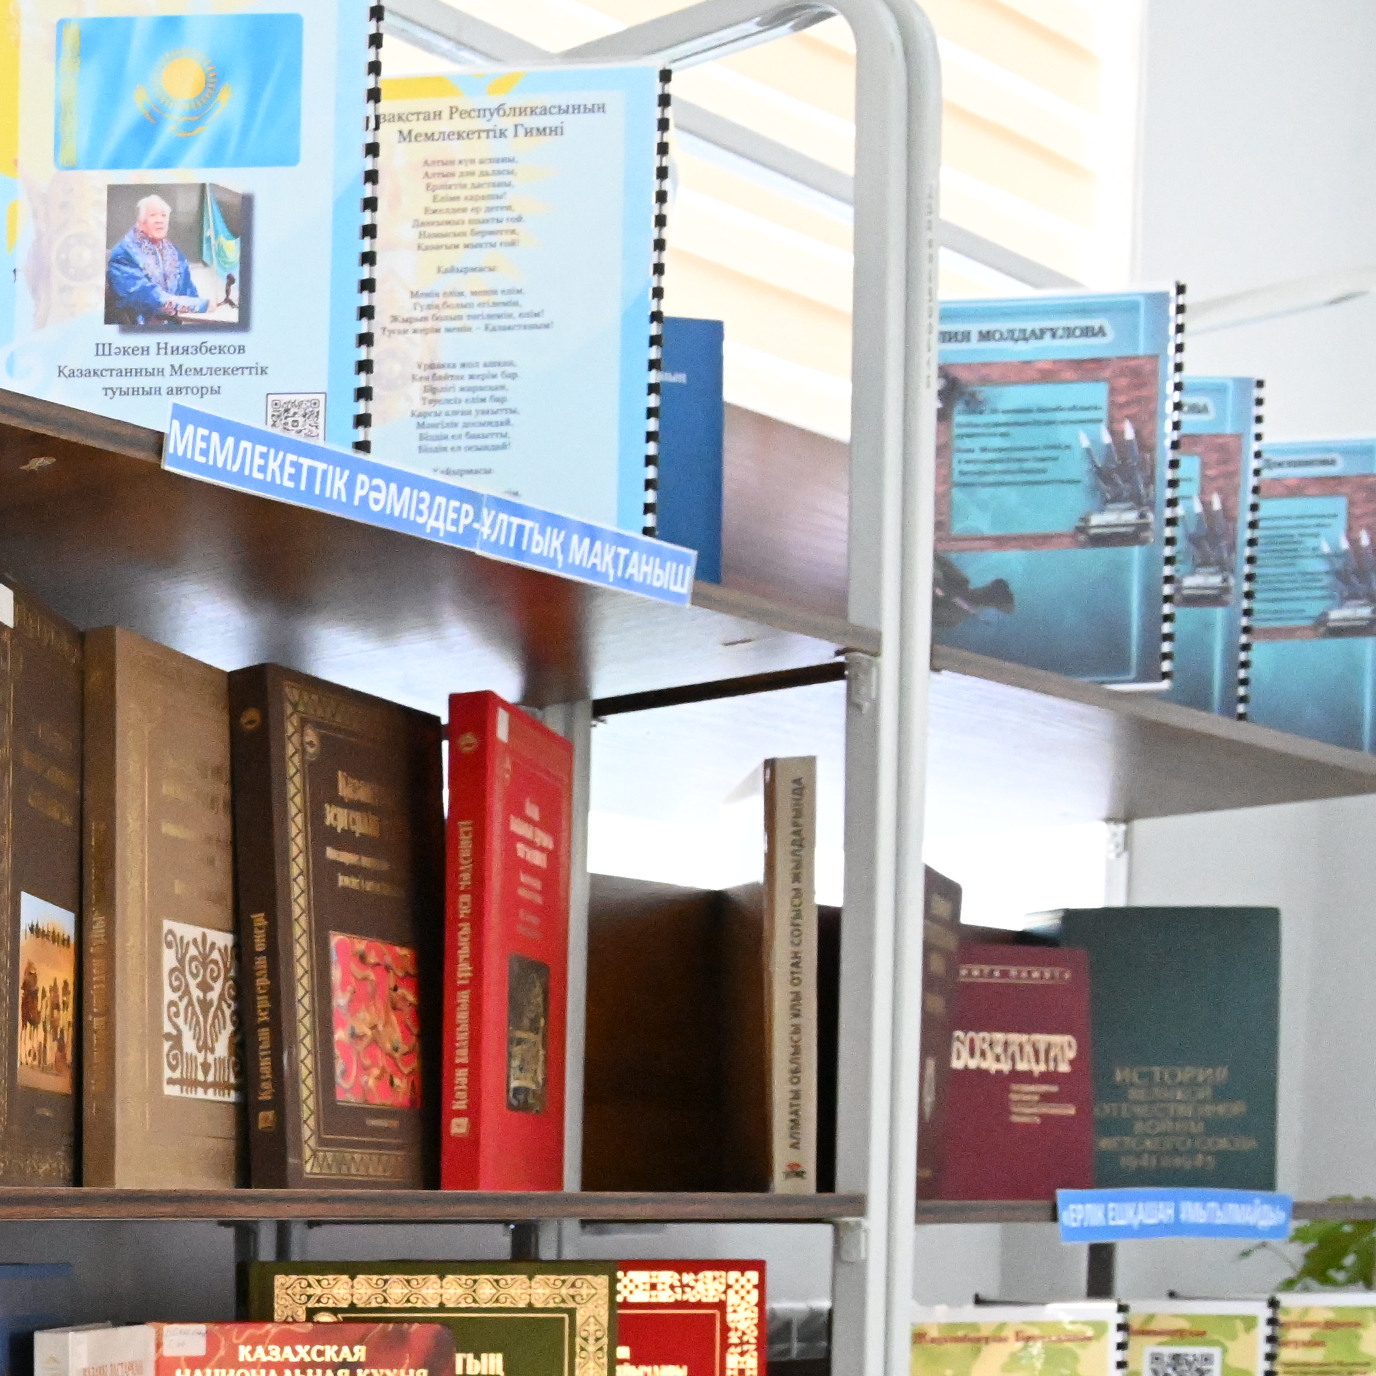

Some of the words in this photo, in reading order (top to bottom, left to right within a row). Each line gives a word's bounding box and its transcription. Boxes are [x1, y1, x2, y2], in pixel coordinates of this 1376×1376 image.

[380, 108, 442, 125] зақстан
[448, 101, 607, 123] Республикасының
[398, 126, 508, 143] Мемлекеттік
[513, 121, 564, 138] Гимні
[94, 342, 151, 358] Шәкен
[156, 341, 246, 356] Ниязбеков
[57, 364, 166, 379] Қазақстанның
[169, 363, 268, 377] Мемлекеттік
[102, 385, 163, 398] туының
[167, 383, 222, 398] авторы
[169, 419, 348, 503] МЕМЛЕКЕТТІК
[569, 535, 692, 595] МАҚТАНЫШ
[787, 951, 802, 987] ОТАН
[787, 1088, 802, 1151] АЛМАТЫ
[237, 1344, 367, 1364] КАЗАХСКАЯ
